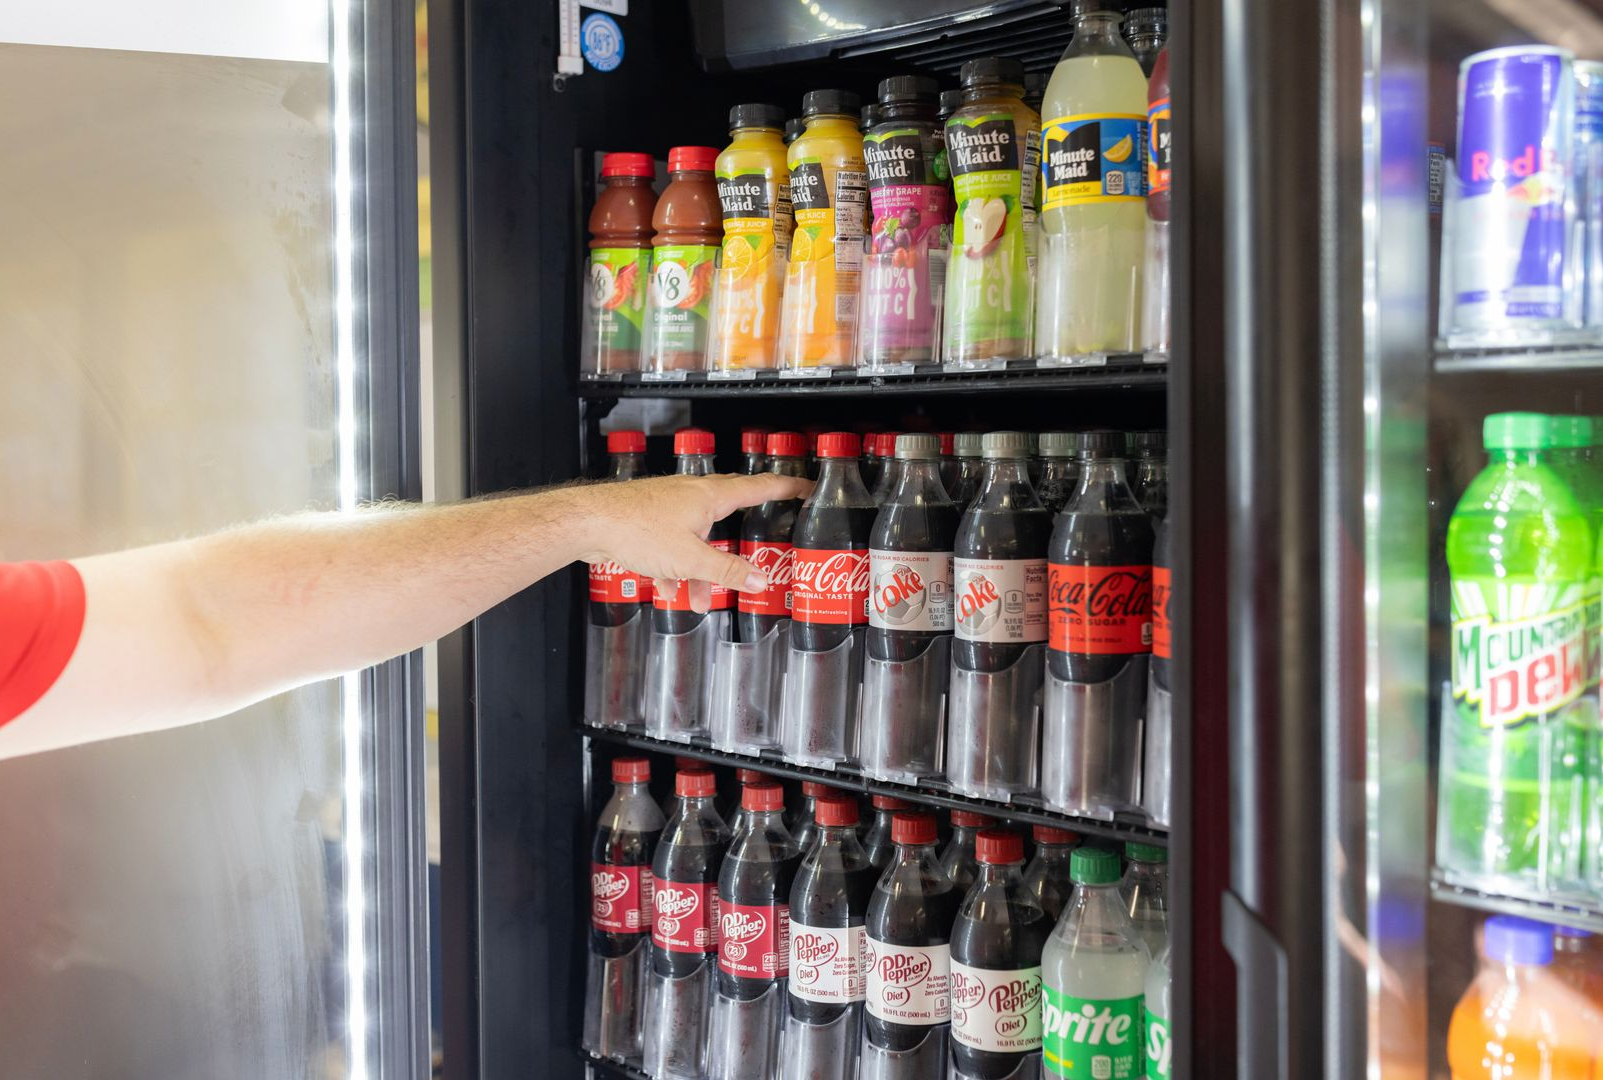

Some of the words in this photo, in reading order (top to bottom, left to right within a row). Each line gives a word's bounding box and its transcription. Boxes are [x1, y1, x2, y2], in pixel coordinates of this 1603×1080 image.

[949, 130, 1010, 150] Minute
[864, 145, 915, 164] Minute
[956, 145, 1002, 167] Maid
[1050, 147, 1096, 167] Minute
[868, 160, 909, 180] Maid
[1054, 162, 1089, 180] Maid
[790, 171, 818, 187] nute
[791, 186, 815, 205] aid
[897, 187, 922, 196] GRAPE
[721, 196, 754, 212] Maid
[658, 267, 681, 301] V8
[871, 267, 906, 290] 100%
[894, 292, 904, 316] C
[795, 591, 824, 600] ORIGINAL
[874, 571, 924, 613] Coke
[936, 583, 941, 593] 0
[1012, 593, 1018, 602] 0
[1058, 616, 1083, 625] ZERO
[592, 873, 626, 898] Pepper
[601, 872, 615, 886] Dr
[656, 890, 694, 916] Pepper
[668, 888, 684, 904] Dr
[722, 913, 763, 940] Pepper
[734, 912, 750, 926] Dr
[795, 935, 835, 962] Pepper
[806, 933, 822, 949] Dr
[882, 955, 928, 984] Pepper
[894, 953, 915, 970] Dr
[800, 969, 814, 979] Diet
[957, 972, 969, 988] Dr
[848, 979, 853, 988] 0
[1009, 980, 1030, 997] Dr
[887, 991, 904, 1001] Diet
[940, 998, 945, 1008] 0
[992, 982, 1041, 1013] Pepper
[1002, 1020, 1021, 1033] Diet
